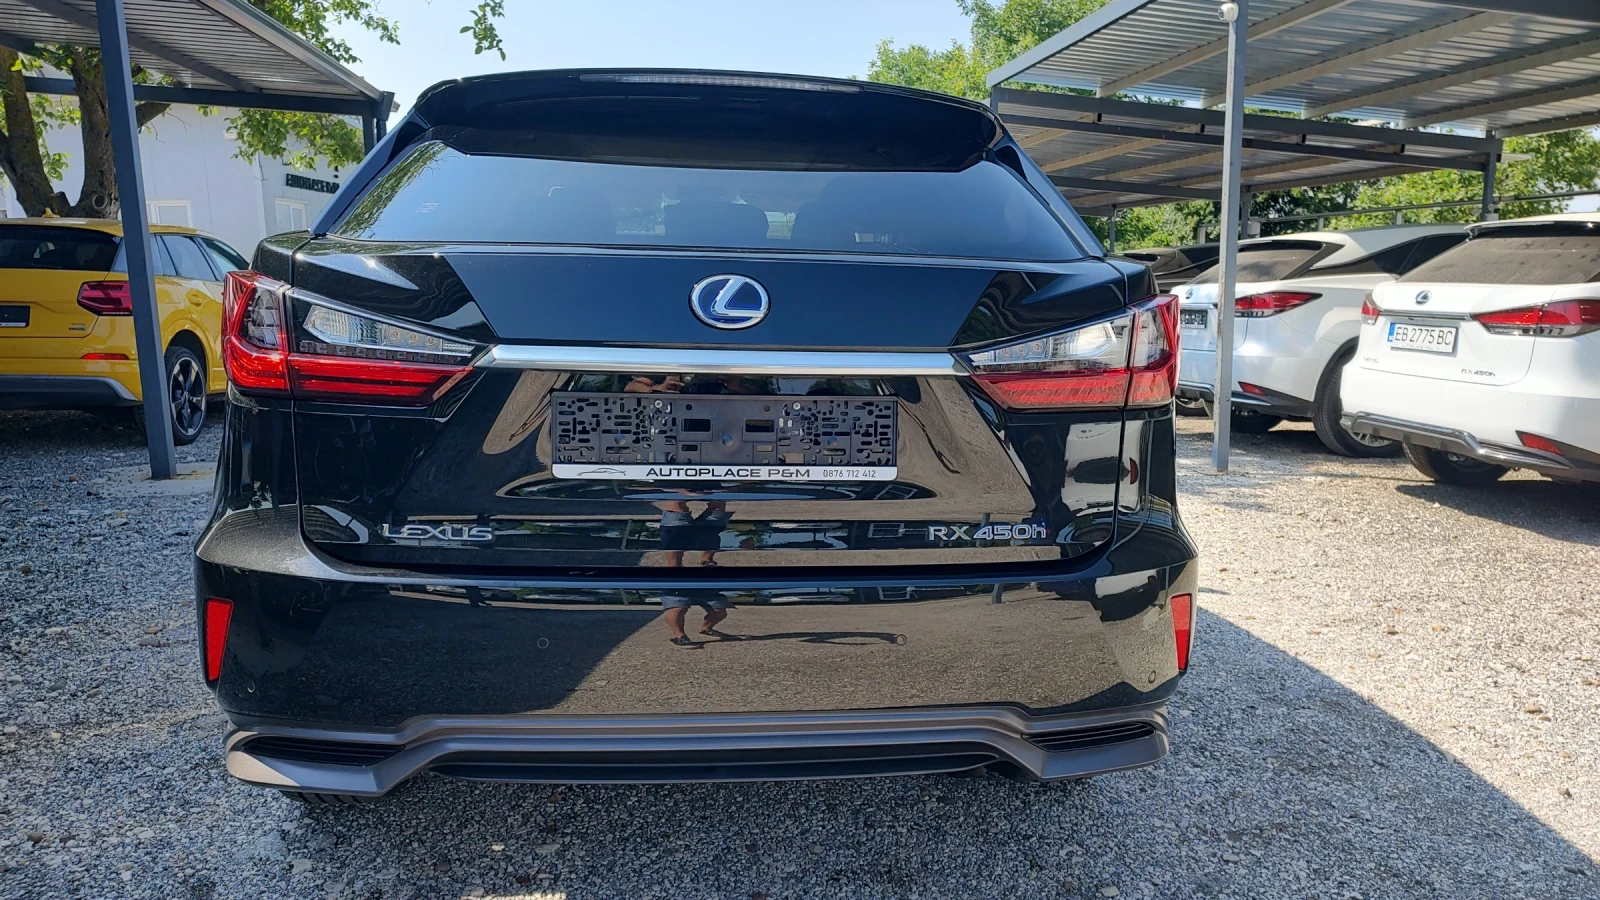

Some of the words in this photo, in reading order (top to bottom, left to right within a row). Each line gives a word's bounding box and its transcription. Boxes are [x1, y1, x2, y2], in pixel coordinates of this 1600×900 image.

[1395, 326, 1409, 342] EB
[1409, 327, 1436, 344] 2775
[1436, 329, 1453, 346] BC
[646, 467, 762, 478] AUTOPLACE
[768, 468, 810, 478] P&M
[822, 469, 844, 478] 0876
[846, 469, 860, 478] 712
[862, 469, 876, 478] 412
[382, 523, 493, 541] LEXUS
[928, 525, 971, 541] RX
[973, 523, 1046, 540] 450h
